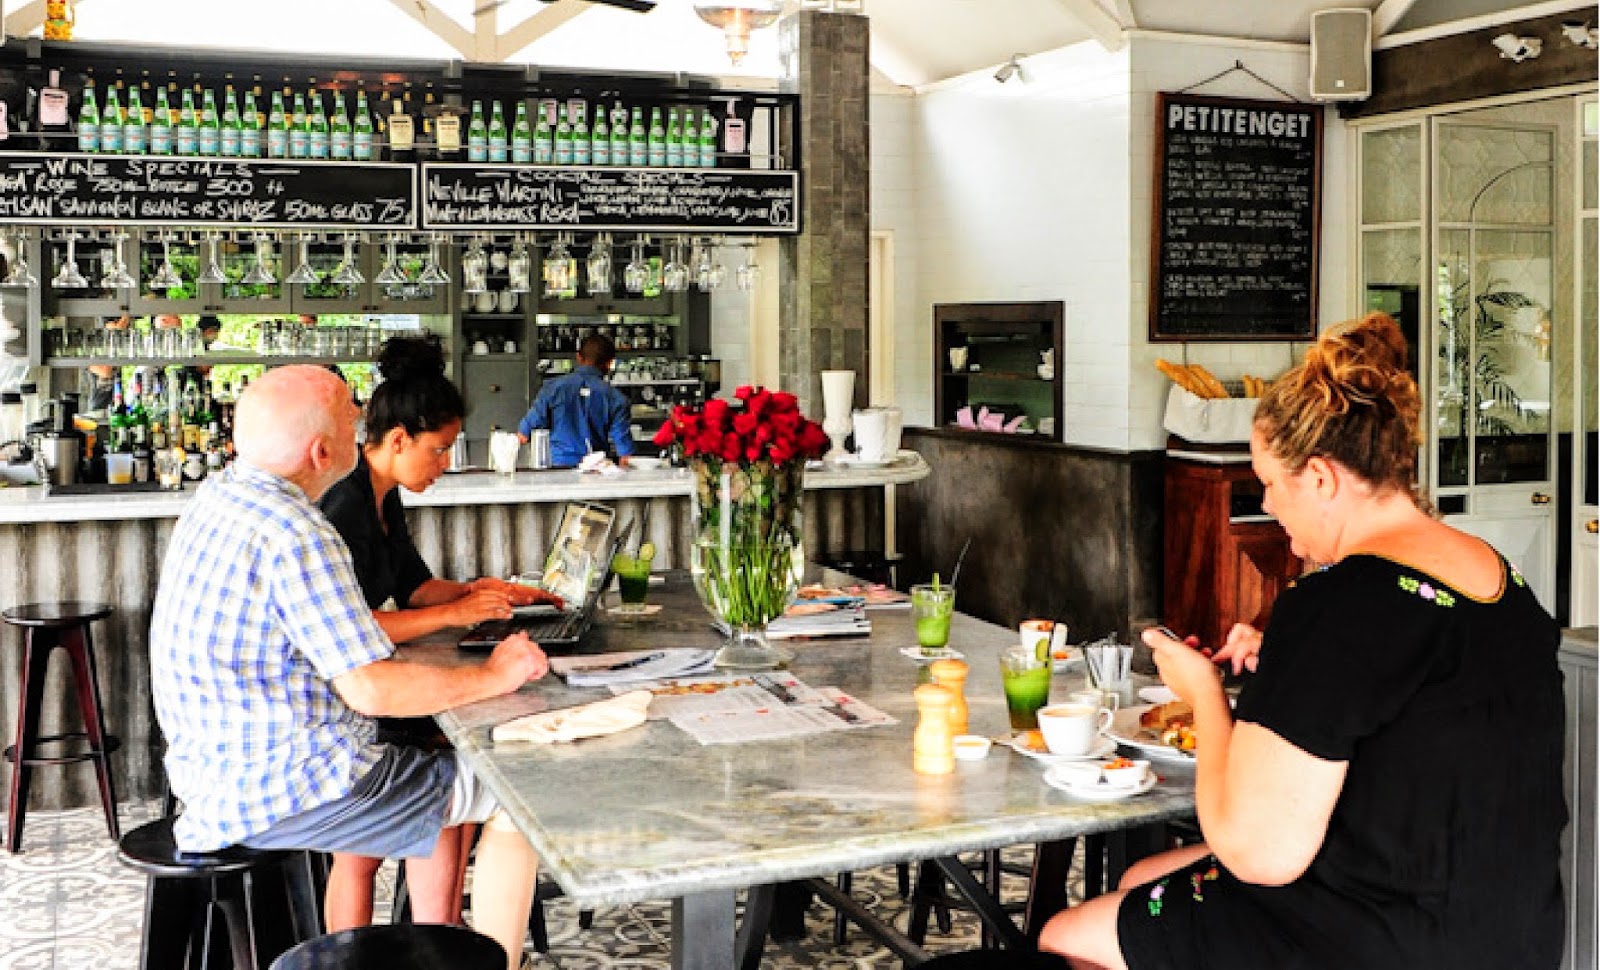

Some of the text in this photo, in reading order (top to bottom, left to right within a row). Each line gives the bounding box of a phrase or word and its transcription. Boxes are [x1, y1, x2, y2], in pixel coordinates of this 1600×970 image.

[1168, 104, 1311, 138] PETITENGET
[45, 158, 253, 184] WINE SPECIALS
[204, 178, 255, 196] 300
